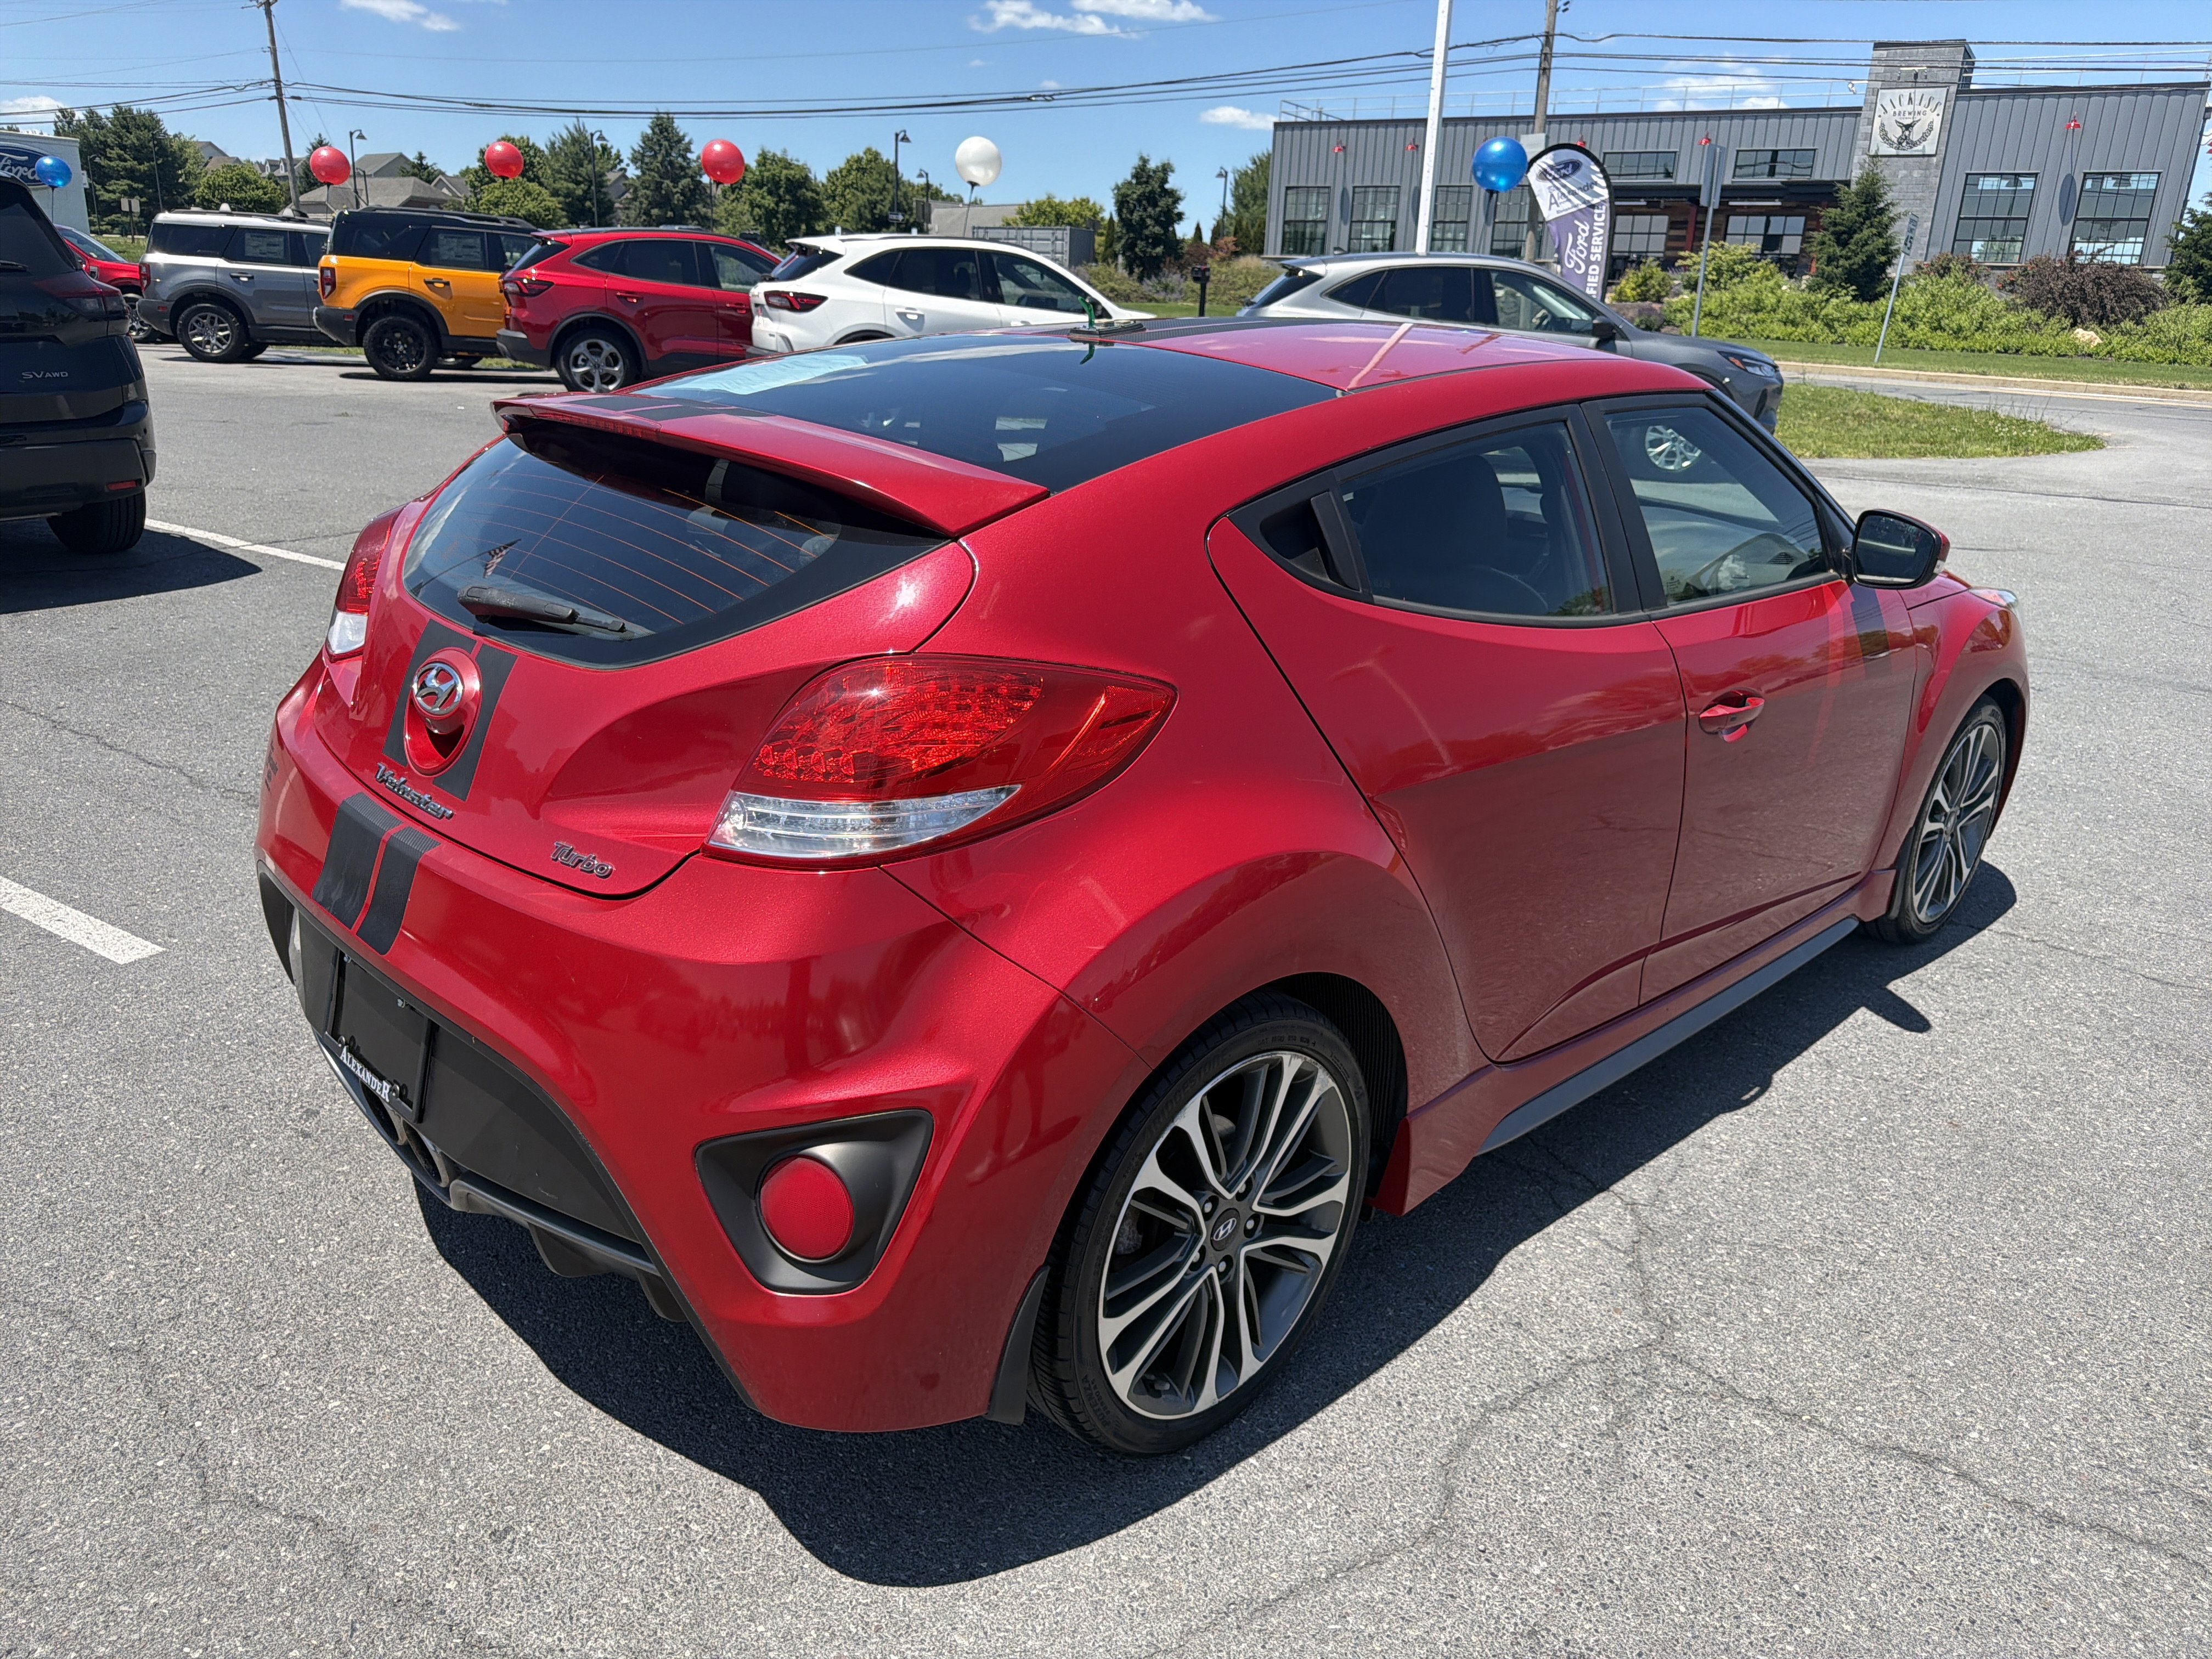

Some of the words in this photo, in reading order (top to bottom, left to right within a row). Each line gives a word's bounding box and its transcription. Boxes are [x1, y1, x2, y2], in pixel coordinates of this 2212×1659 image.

[1565, 219, 1590, 274] Ford
[1590, 205, 1607, 262] SERVICE
[375, 762, 454, 820] Veloster
[550, 842, 614, 879] Turbo
[340, 1045, 392, 1103] ALEXANDER
[1082, 1374, 1111, 1427] POTENZA
